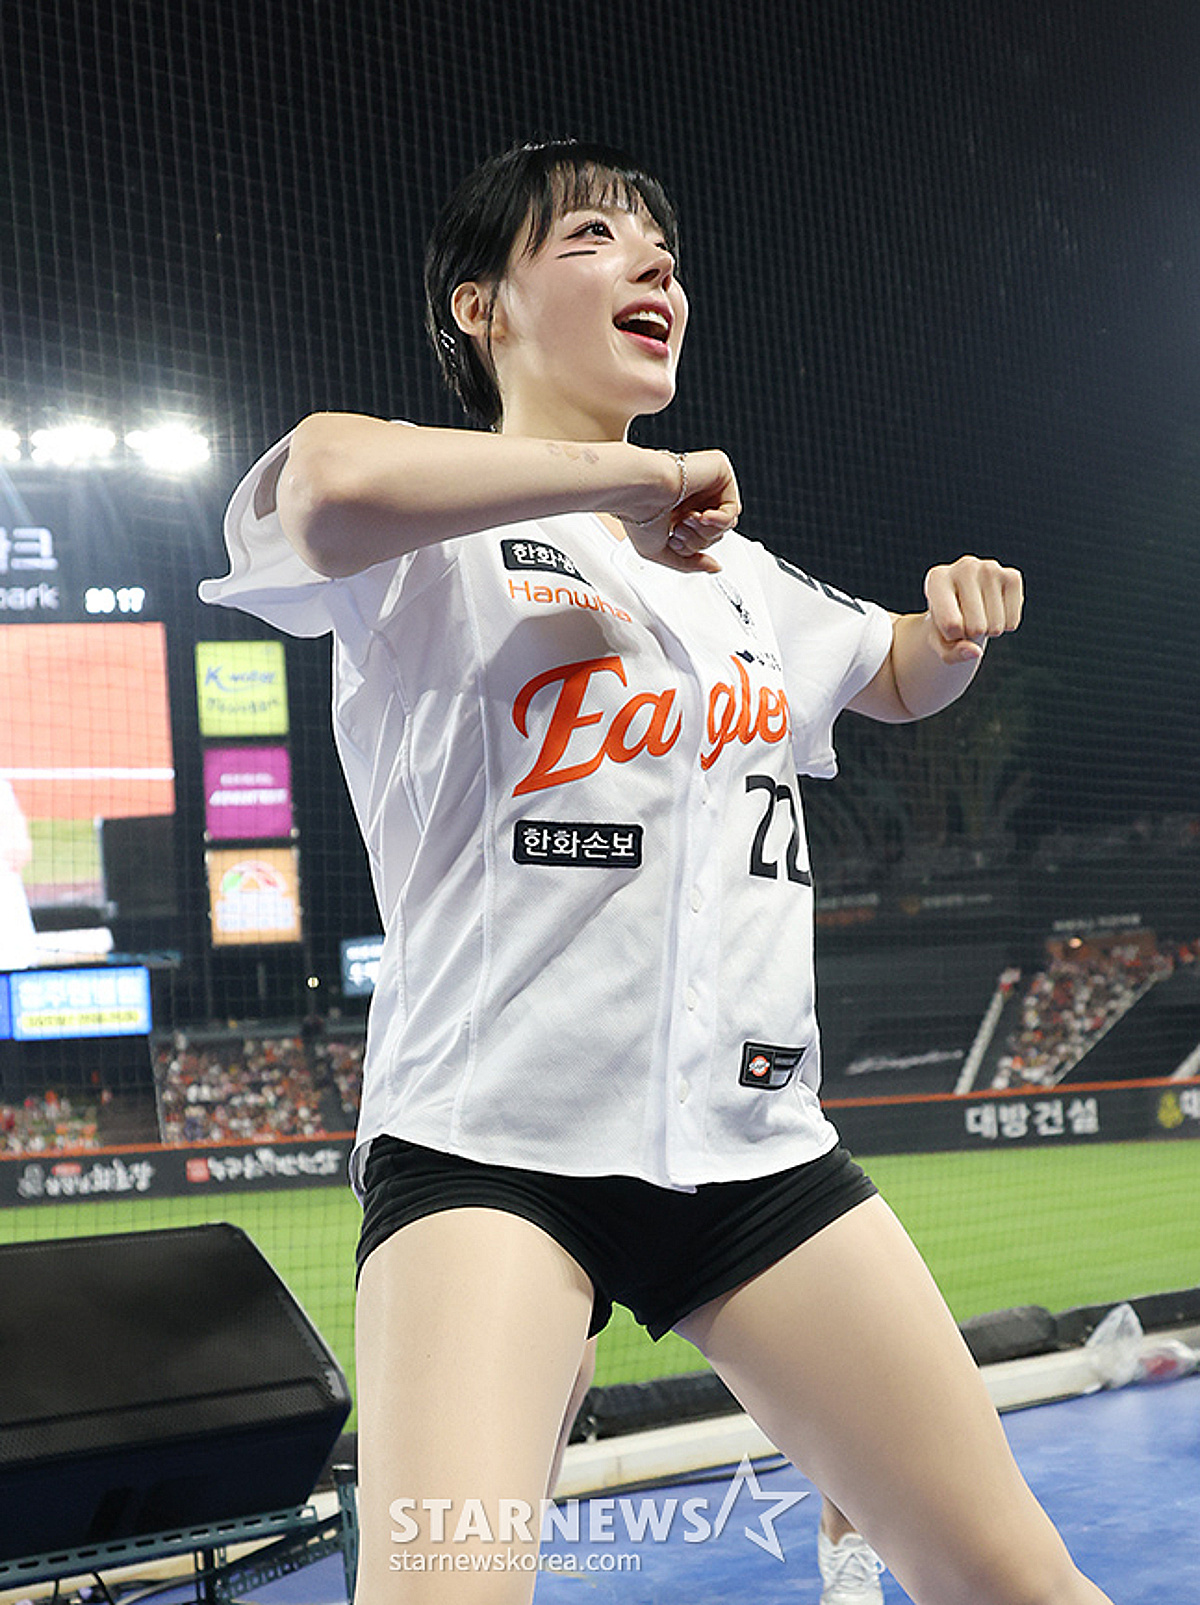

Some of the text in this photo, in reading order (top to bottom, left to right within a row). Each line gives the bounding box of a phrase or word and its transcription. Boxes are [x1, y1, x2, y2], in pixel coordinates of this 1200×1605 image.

[508, 578, 633, 623] Hanwha
[522, 827, 636, 859] 한화손보
[745, 774, 812, 887] 22
